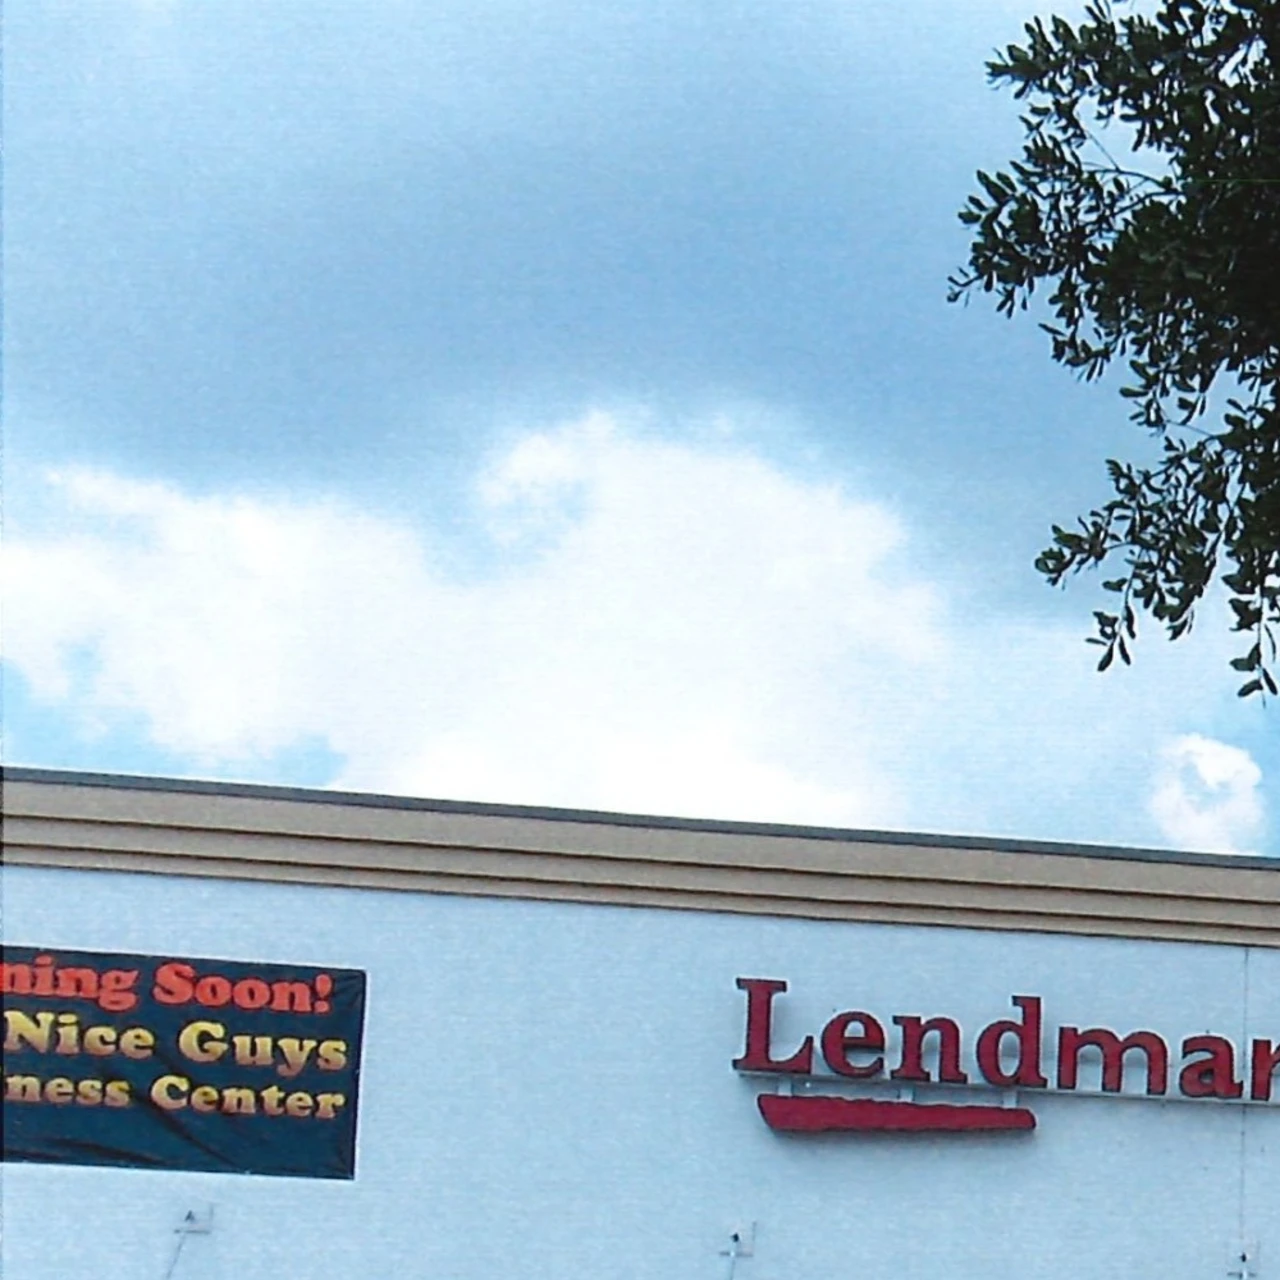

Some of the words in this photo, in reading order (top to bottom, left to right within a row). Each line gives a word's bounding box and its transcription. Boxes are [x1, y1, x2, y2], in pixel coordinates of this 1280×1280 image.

[154, 962, 333, 1014] Soon!
[3, 1010, 155, 1059] Nice
[179, 1020, 348, 1077] Guys
[150, 1075, 346, 1119] Center
